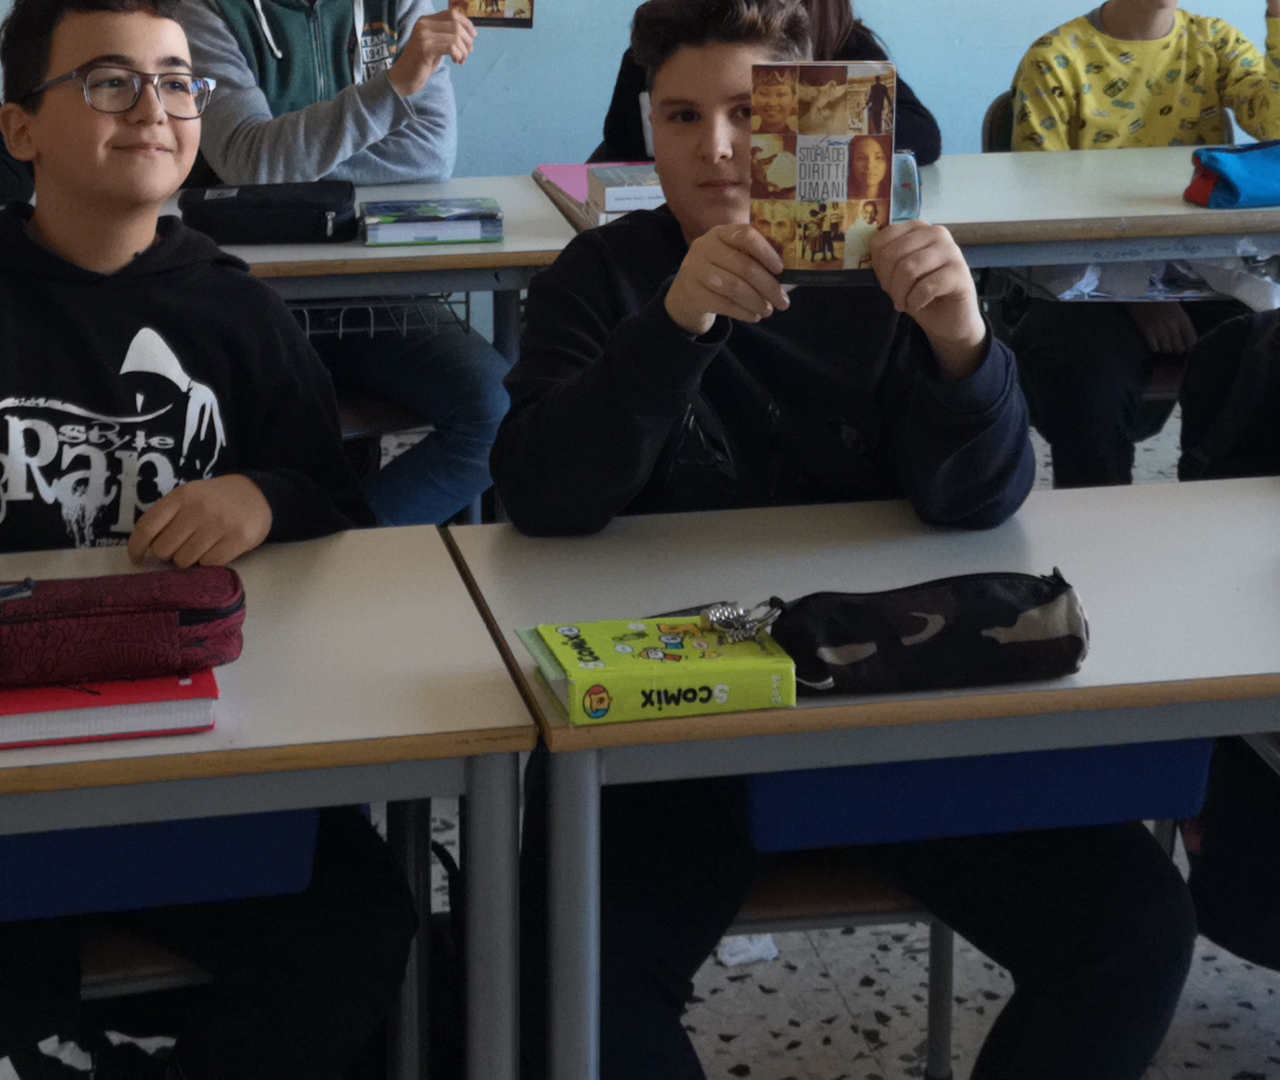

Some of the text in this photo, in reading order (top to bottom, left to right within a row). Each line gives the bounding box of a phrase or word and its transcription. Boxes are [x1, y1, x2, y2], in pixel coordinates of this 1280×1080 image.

[798, 146, 846, 163] STORIA DEI
[798, 163, 846, 181] DIRITTI
[798, 180, 845, 199] UMANI
[4, 415, 182, 542] Rap
